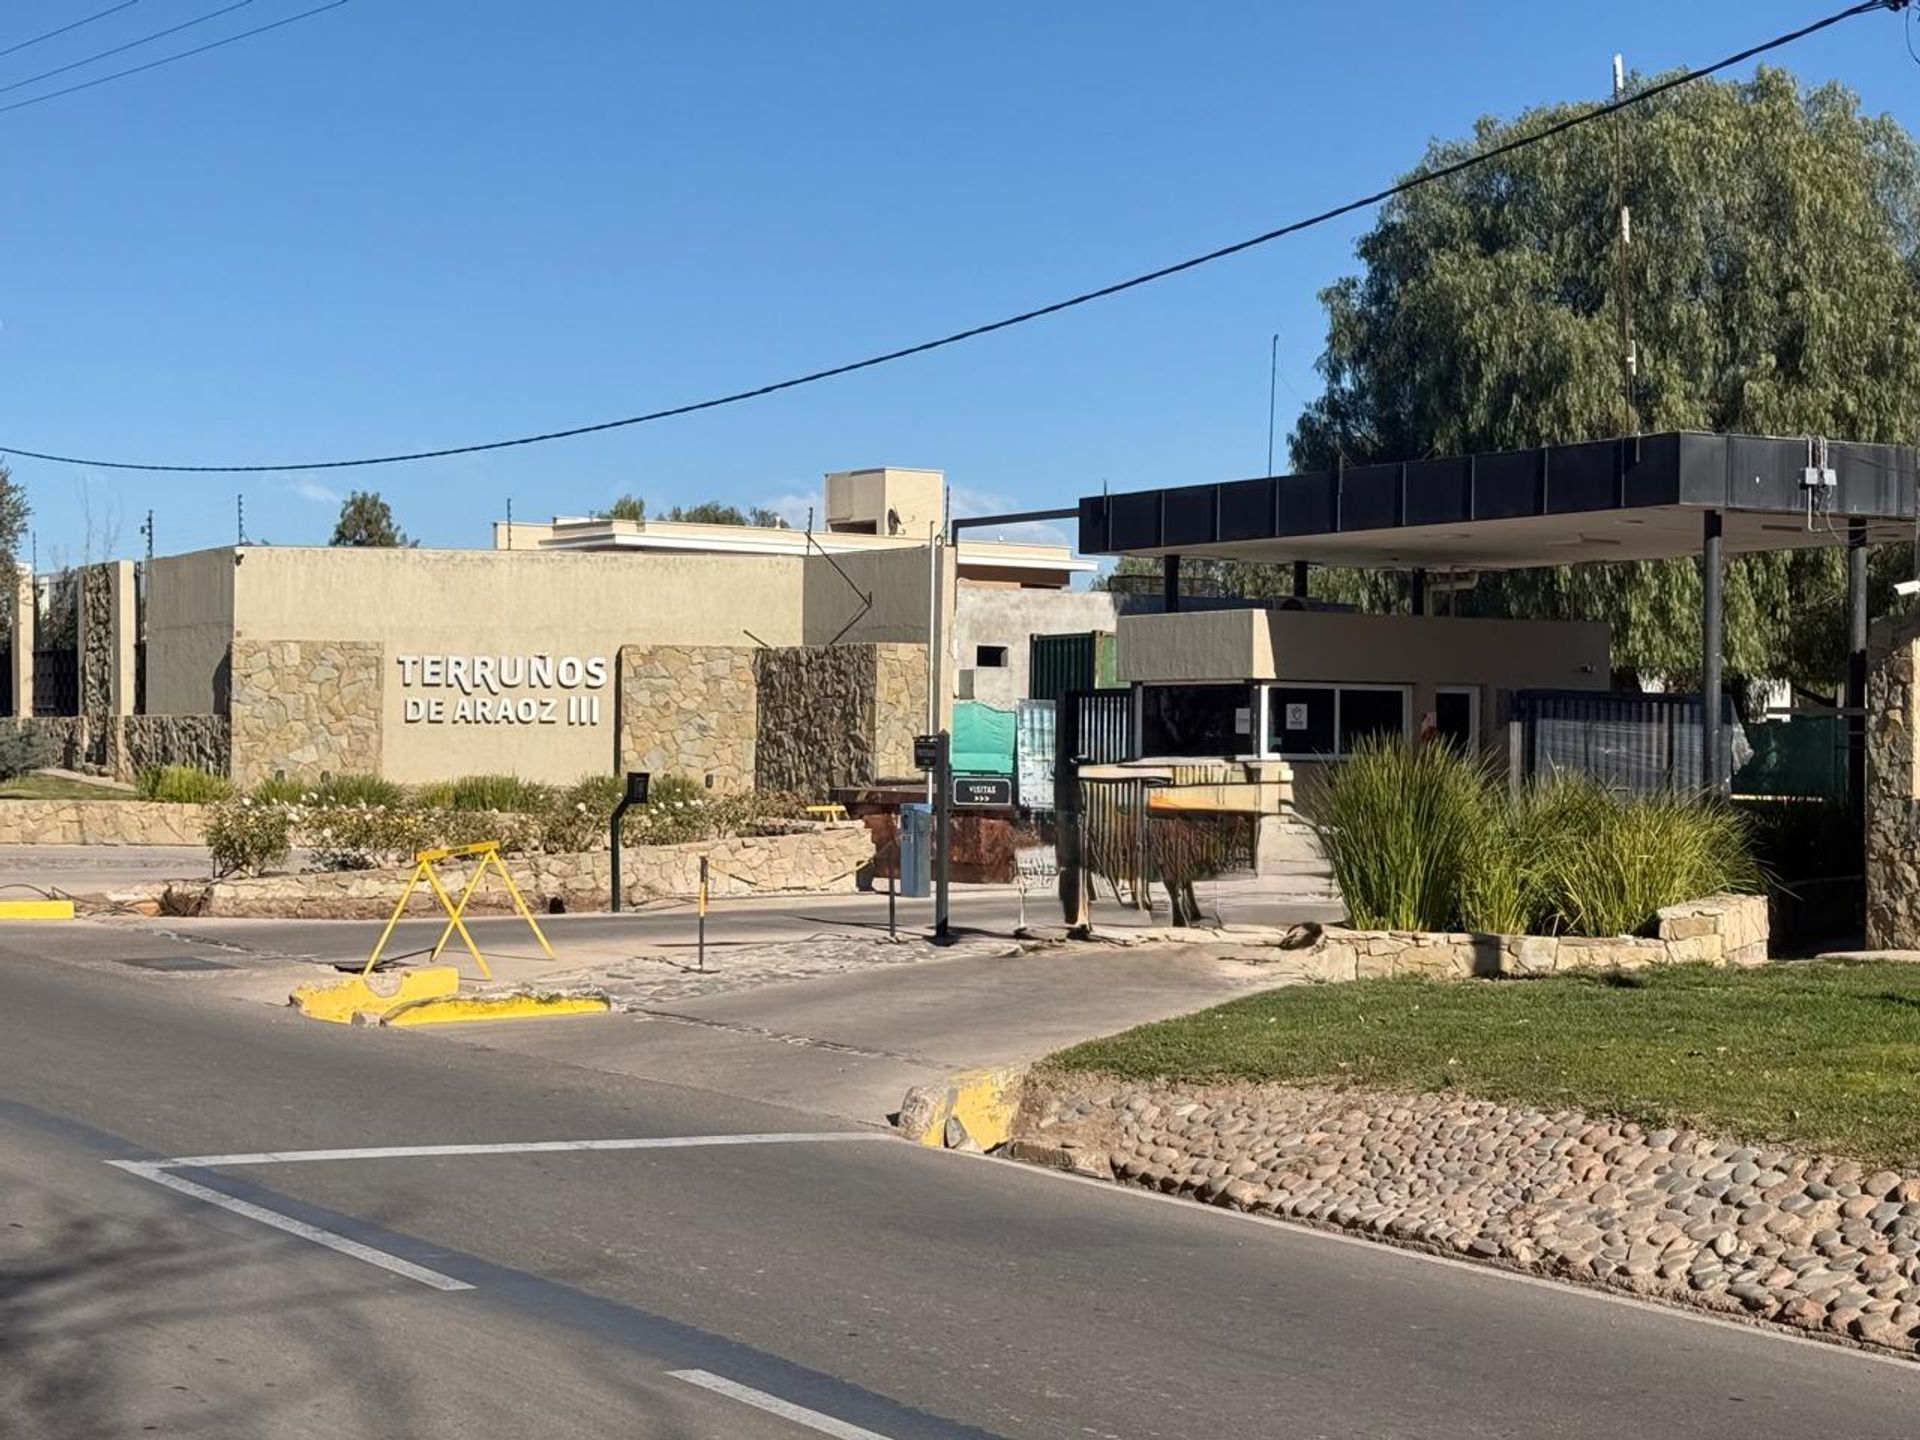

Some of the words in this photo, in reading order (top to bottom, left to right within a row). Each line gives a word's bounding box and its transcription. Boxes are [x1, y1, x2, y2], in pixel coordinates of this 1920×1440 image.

[398, 652, 608, 695] TERRUÑOS
[405, 698, 444, 723] DE
[453, 698, 557, 724] ARAOZ
[568, 696, 600, 725] III
[969, 785, 996, 794] VISITAS
